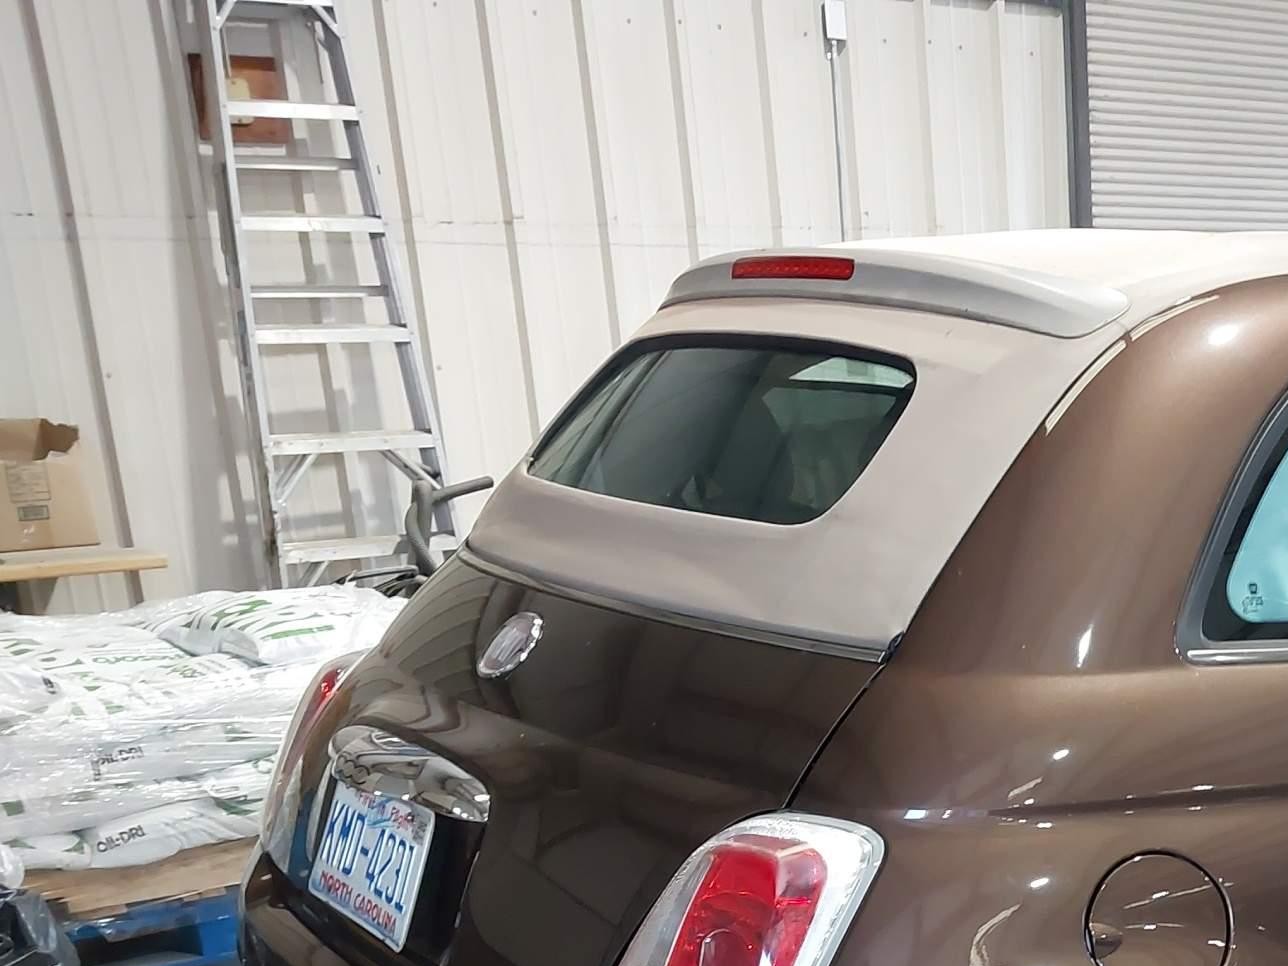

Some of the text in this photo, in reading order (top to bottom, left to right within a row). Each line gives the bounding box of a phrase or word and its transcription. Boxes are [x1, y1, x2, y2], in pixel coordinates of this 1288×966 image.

[96, 824, 147, 853] OIL-DRI
[320, 800, 416, 914] KMD-4231
[318, 870, 398, 937] NORTH CAROLINA
